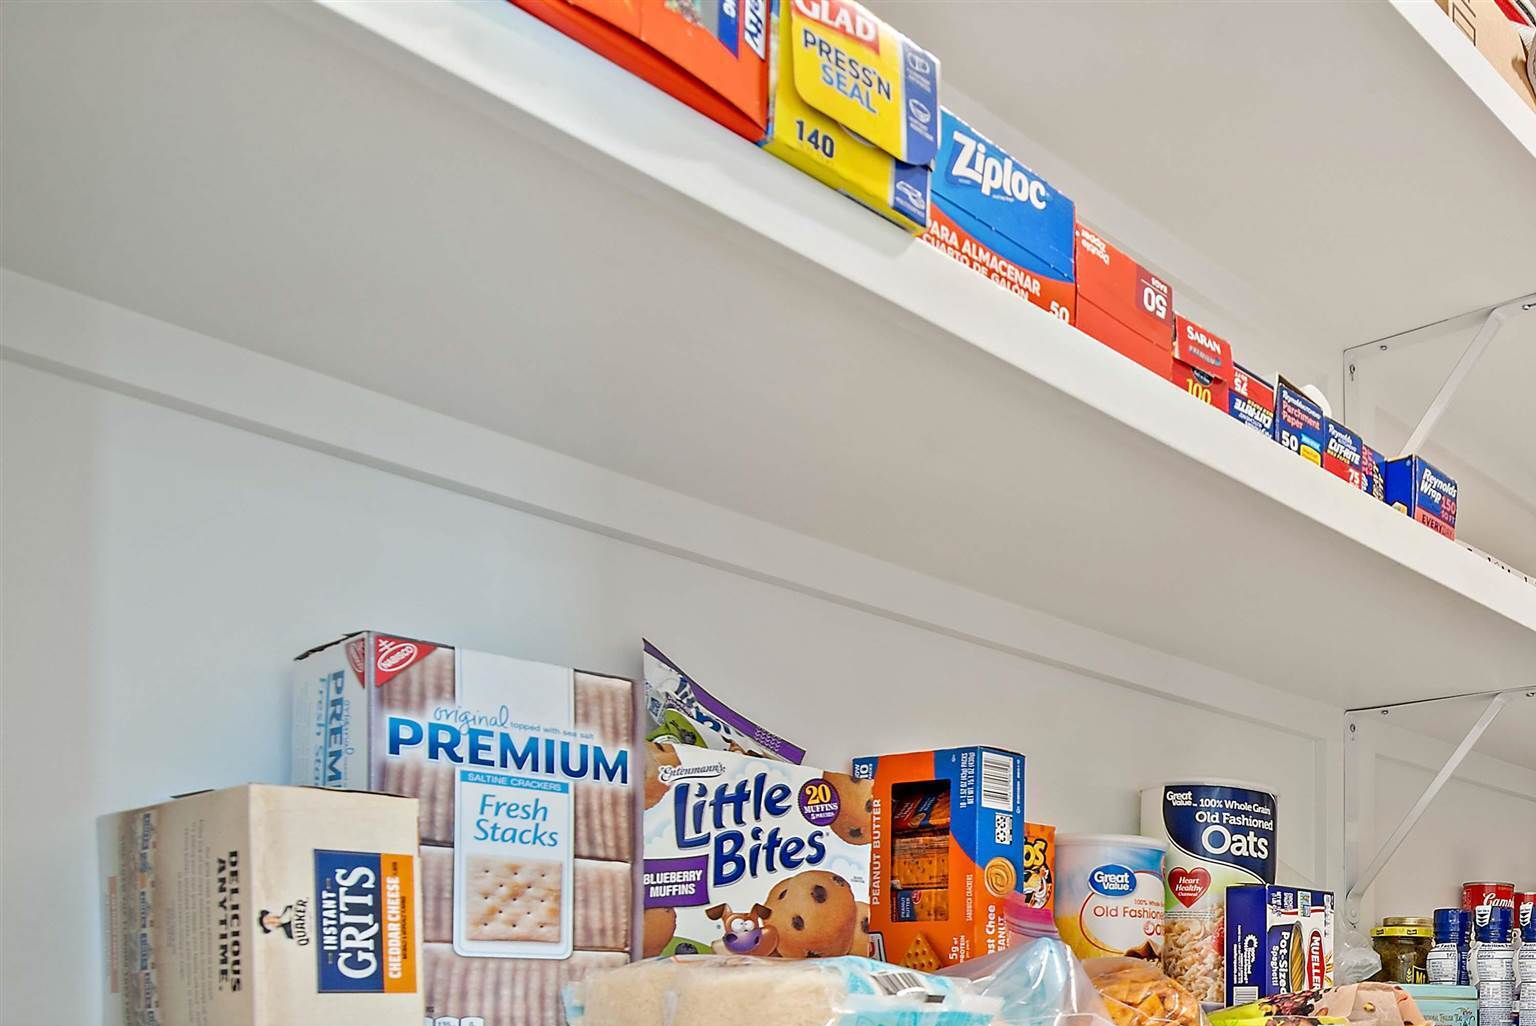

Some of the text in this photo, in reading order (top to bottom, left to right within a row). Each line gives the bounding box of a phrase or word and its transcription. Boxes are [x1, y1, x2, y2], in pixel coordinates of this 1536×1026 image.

[821, 64, 877, 113] SEAL
[796, 120, 835, 158] 140
[951, 130, 1048, 210] Ziploc
[963, 239, 1041, 298] ALMACENAR
[1143, 287, 1168, 320] 50
[1186, 325, 1222, 354] SARAN
[1187, 378, 1212, 405] 100
[1283, 400, 1320, 431] Parchment
[1420, 480, 1442, 504] Wrap
[1424, 468, 1458, 498] Reynolds
[433, 704, 510, 736] original
[510, 721, 595, 740] topped with salt
[387, 714, 630, 785] PREMIUM
[468, 772, 562, 792] SALTINE CRACKERS
[805, 783, 831, 804] 20
[1166, 790, 1192, 801] Great
[479, 794, 548, 822] Fresh
[675, 773, 793, 850] Little
[803, 800, 839, 815] MUFFINS
[1171, 799, 1192, 807] Value
[1199, 798, 1271, 816] 100% Whole Grain
[473, 817, 559, 847] Stacks
[1195, 811, 1274, 831] Old Fashioned
[713, 826, 827, 888] Bites
[871, 799, 881, 906] PEANUT BUTTER
[1201, 825, 1270, 860] Oats
[643, 869, 703, 886] BLUEBERRY
[649, 883, 696, 898] MUFFINS
[1093, 871, 1130, 884] Great
[1102, 880, 1132, 892] Value
[1174, 883, 1204, 894] Healthy
[1178, 876, 1201, 885] Heart
[228, 850, 242, 993] DELICIOUS
[297, 898, 309, 946] QUAKER
[322, 890, 338, 951] INSTANT
[335, 866, 380, 979] GRITS
[386, 876, 402, 979] CHEDDAR CHEESE
[1093, 906, 1121, 920] Old
[1270, 945, 1279, 987] Spaghetti
